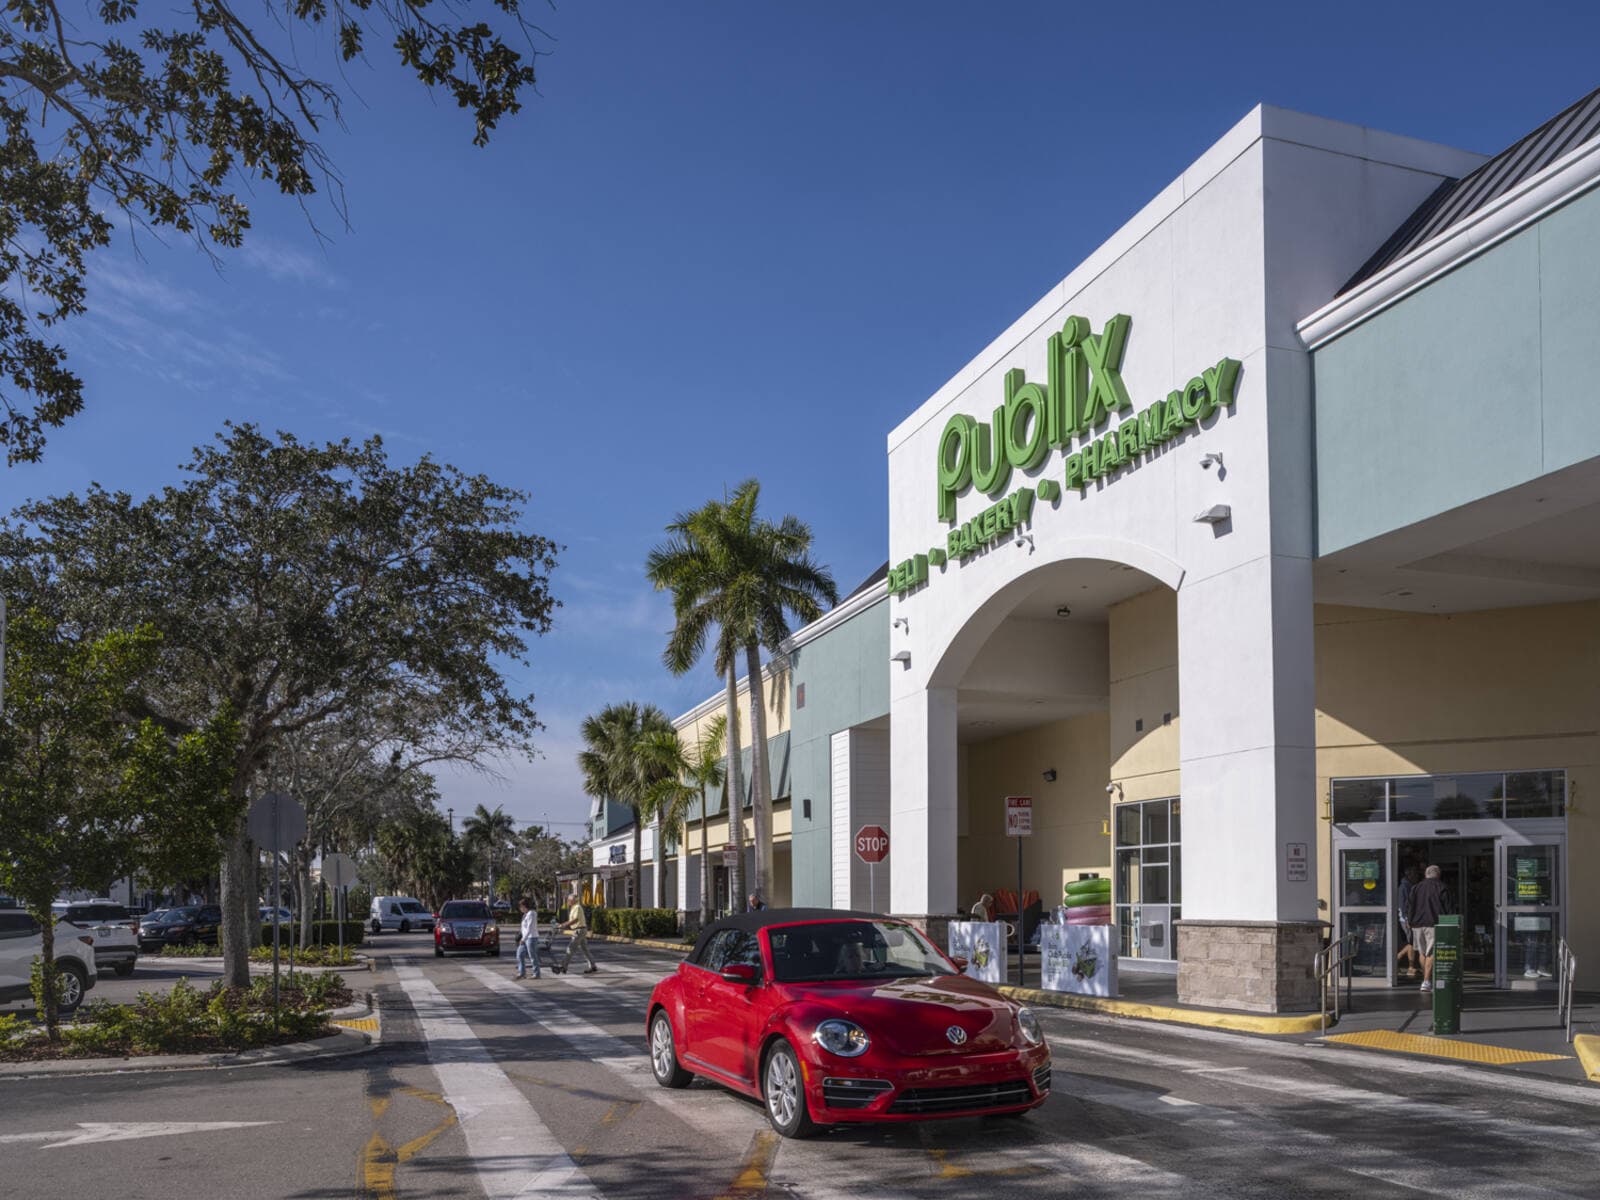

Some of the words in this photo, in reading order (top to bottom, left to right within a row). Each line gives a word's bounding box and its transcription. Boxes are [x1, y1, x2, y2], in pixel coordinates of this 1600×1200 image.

[887, 553, 928, 595] DELI
[947, 487, 1035, 560] BAKERY
[1065, 356, 1242, 491] PHARMACY
[858, 837, 887, 852] STOP
